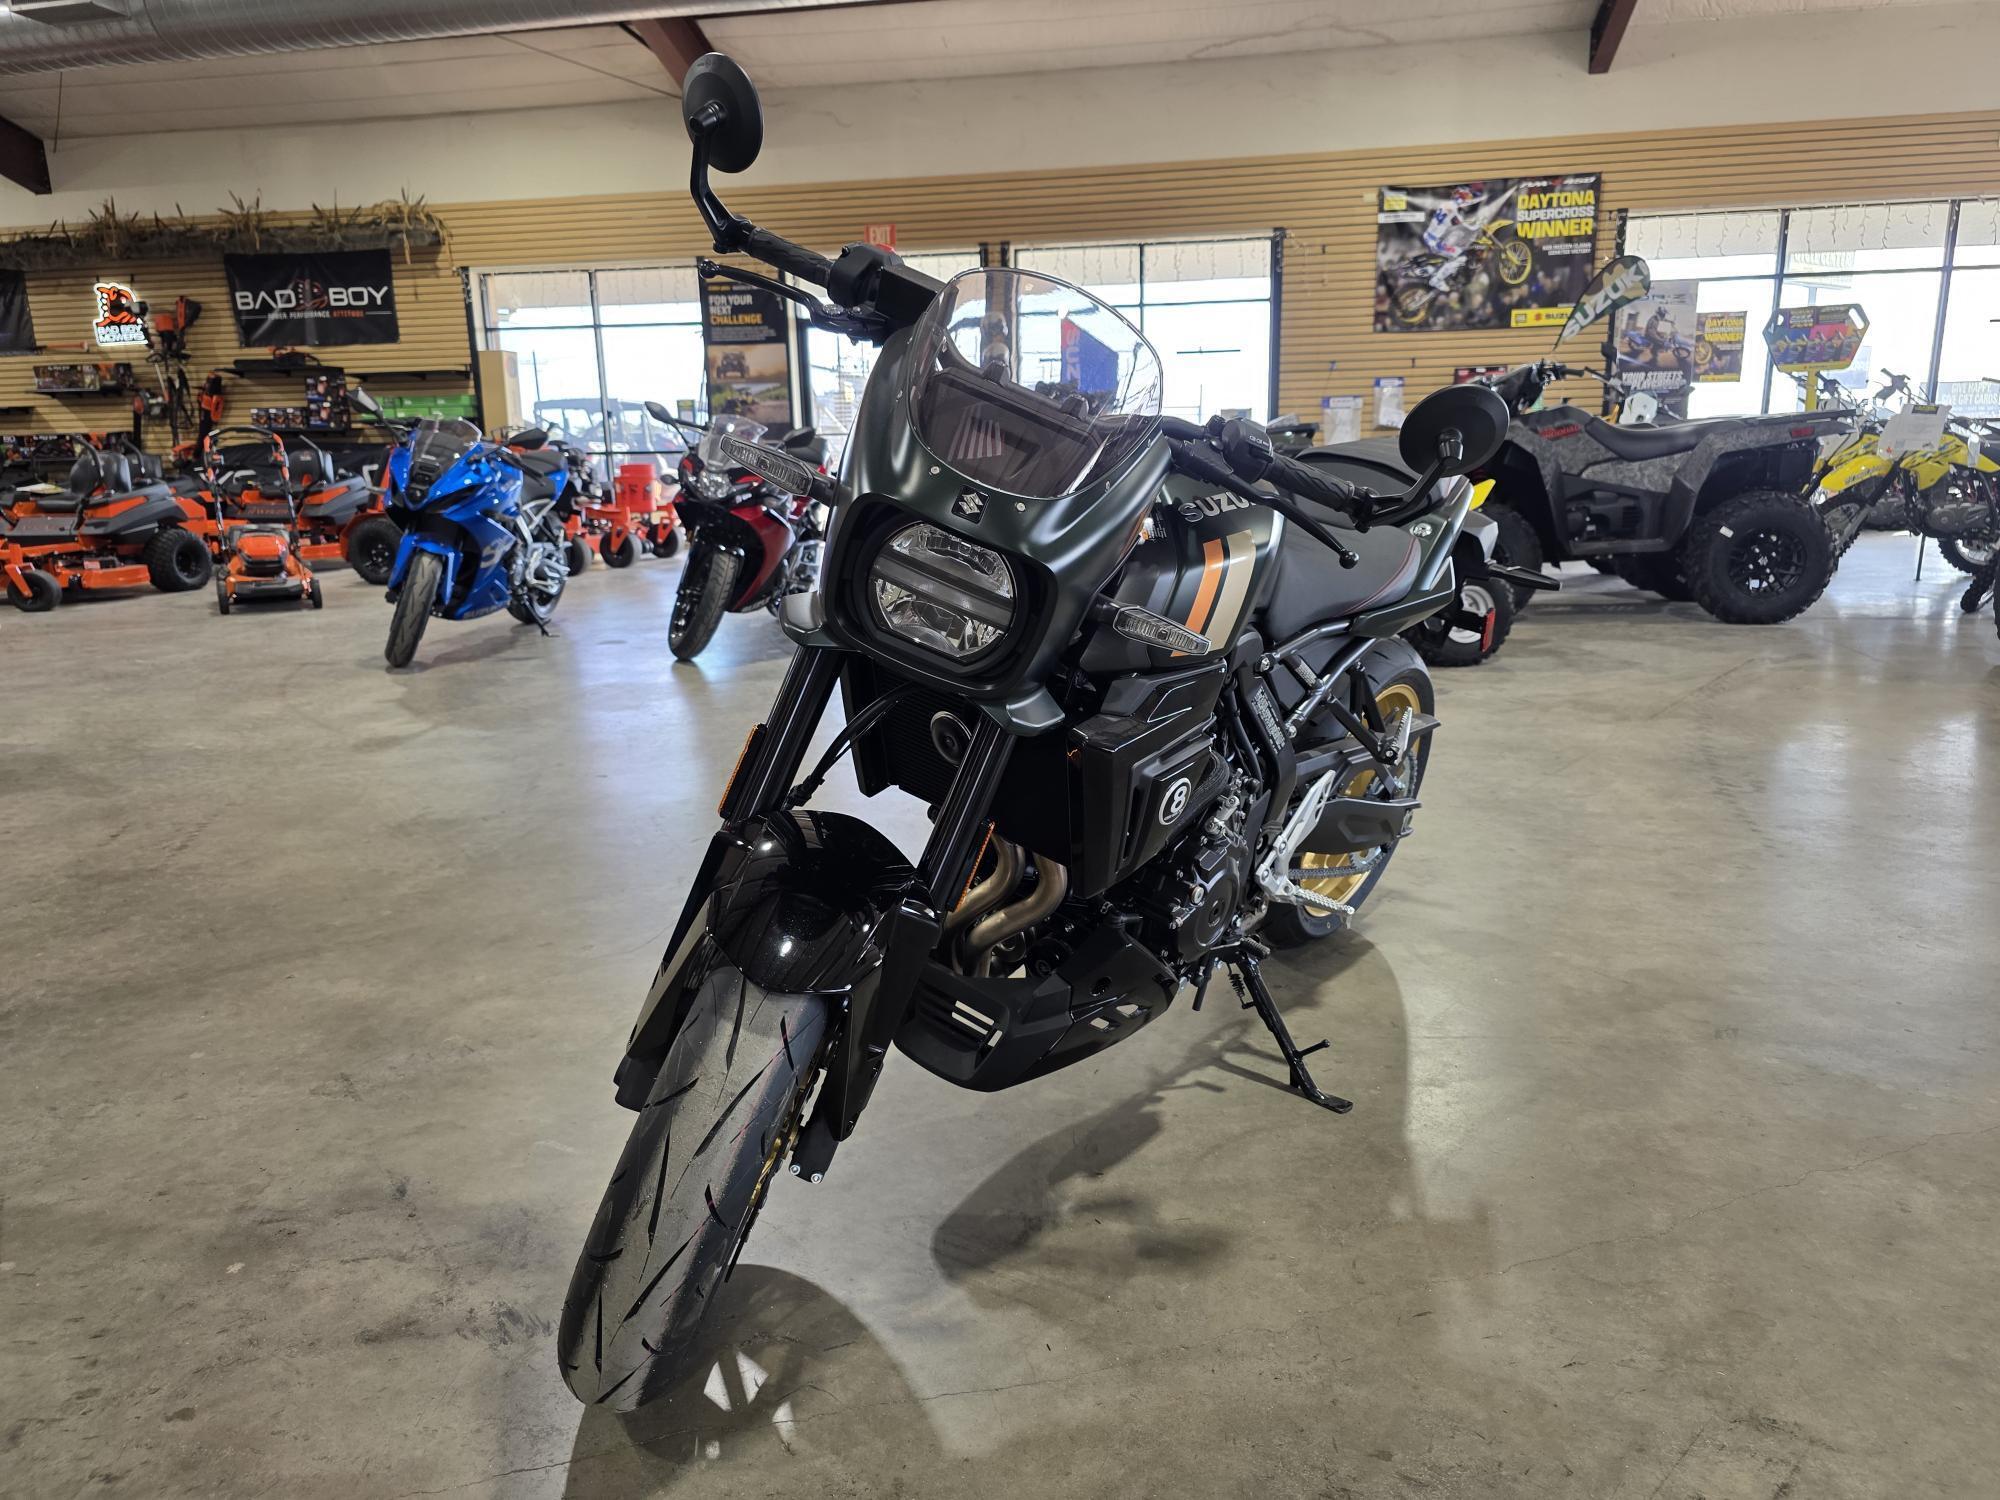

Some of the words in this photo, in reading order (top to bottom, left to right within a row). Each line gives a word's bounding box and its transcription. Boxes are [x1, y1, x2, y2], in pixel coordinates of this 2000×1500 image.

[1517, 190, 1595, 210] DAYTONA
[1517, 206, 1595, 222] SUPERCROSS
[869, 225, 891, 245] EXIT
[1517, 218, 1593, 239] WINNER
[234, 288, 297, 311] BAD
[328, 286, 389, 307] BOY
[709, 295, 727, 306] FOR
[728, 294, 753, 306] YOUR
[1560, 259, 1650, 341] SUZUKI
[709, 305, 732, 315] NEXT
[711, 313, 763, 326] CHALLENGE
[1178, 491, 1256, 523] SUZU
[1171, 786, 1187, 814] 8
